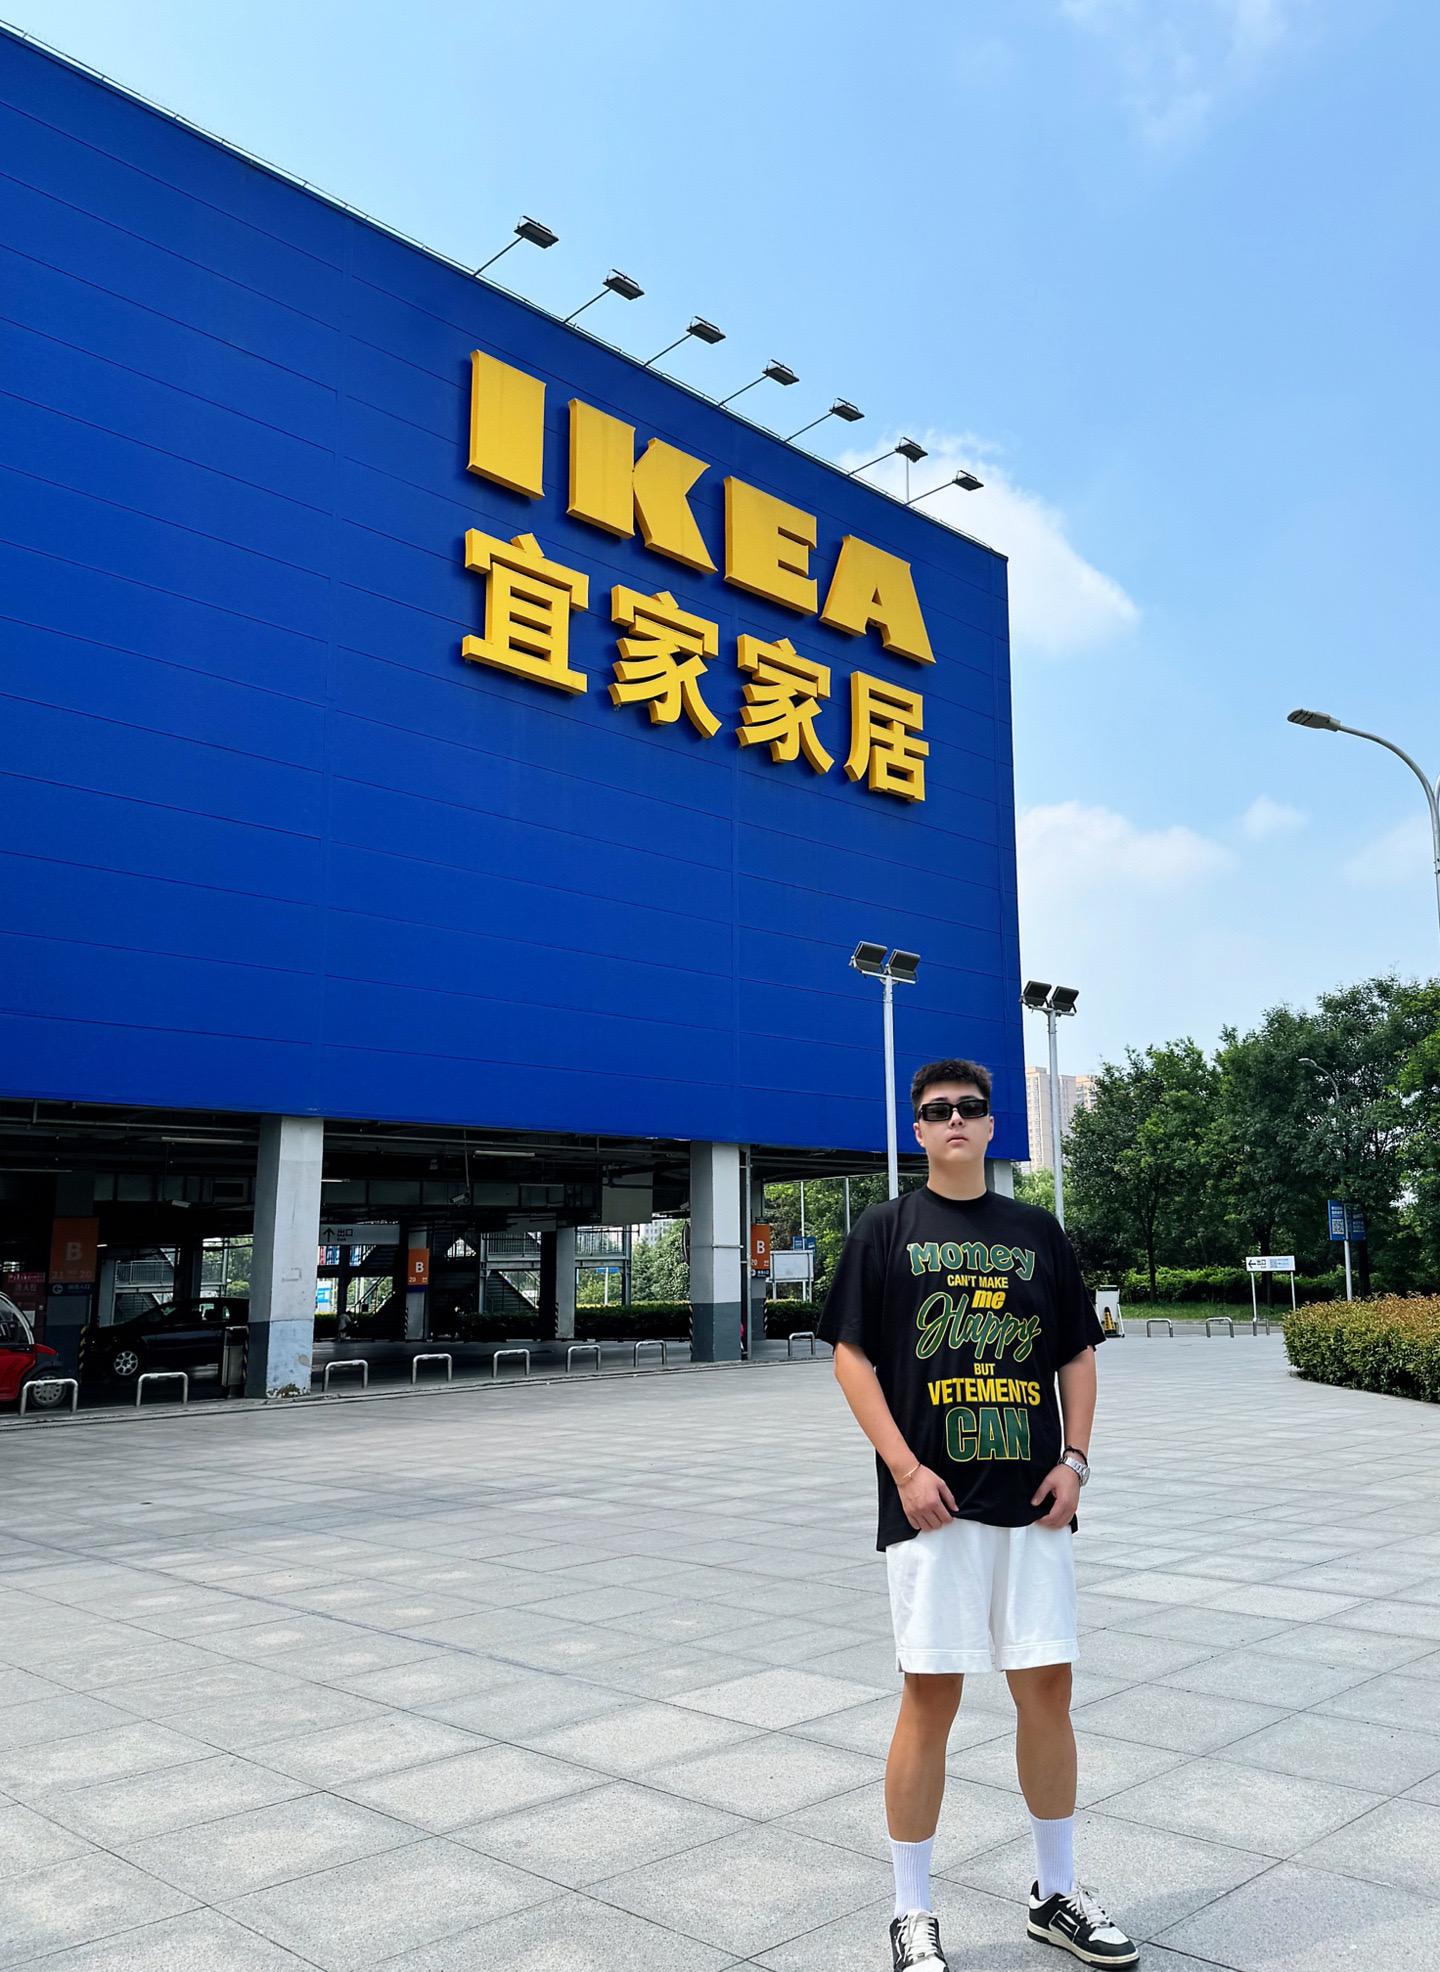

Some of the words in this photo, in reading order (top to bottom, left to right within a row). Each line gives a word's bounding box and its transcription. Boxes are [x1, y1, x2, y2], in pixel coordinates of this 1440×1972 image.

[466, 349, 936, 664] IKEA
[462, 528, 929, 802] 宜家家居
[64, 1242, 82, 1260] B
[756, 1240, 766, 1255] B
[415, 1261, 424, 1273] B
[947, 1274, 977, 1288] CAN'T
[979, 1276, 1009, 1289] MAKE
[972, 1289, 1006, 1310] me
[916, 1291, 1042, 1363] Happy
[974, 1363, 996, 1376] BUT
[928, 1378, 1041, 1406] VETEMENTS
[945, 1406, 1031, 1463] CAN
